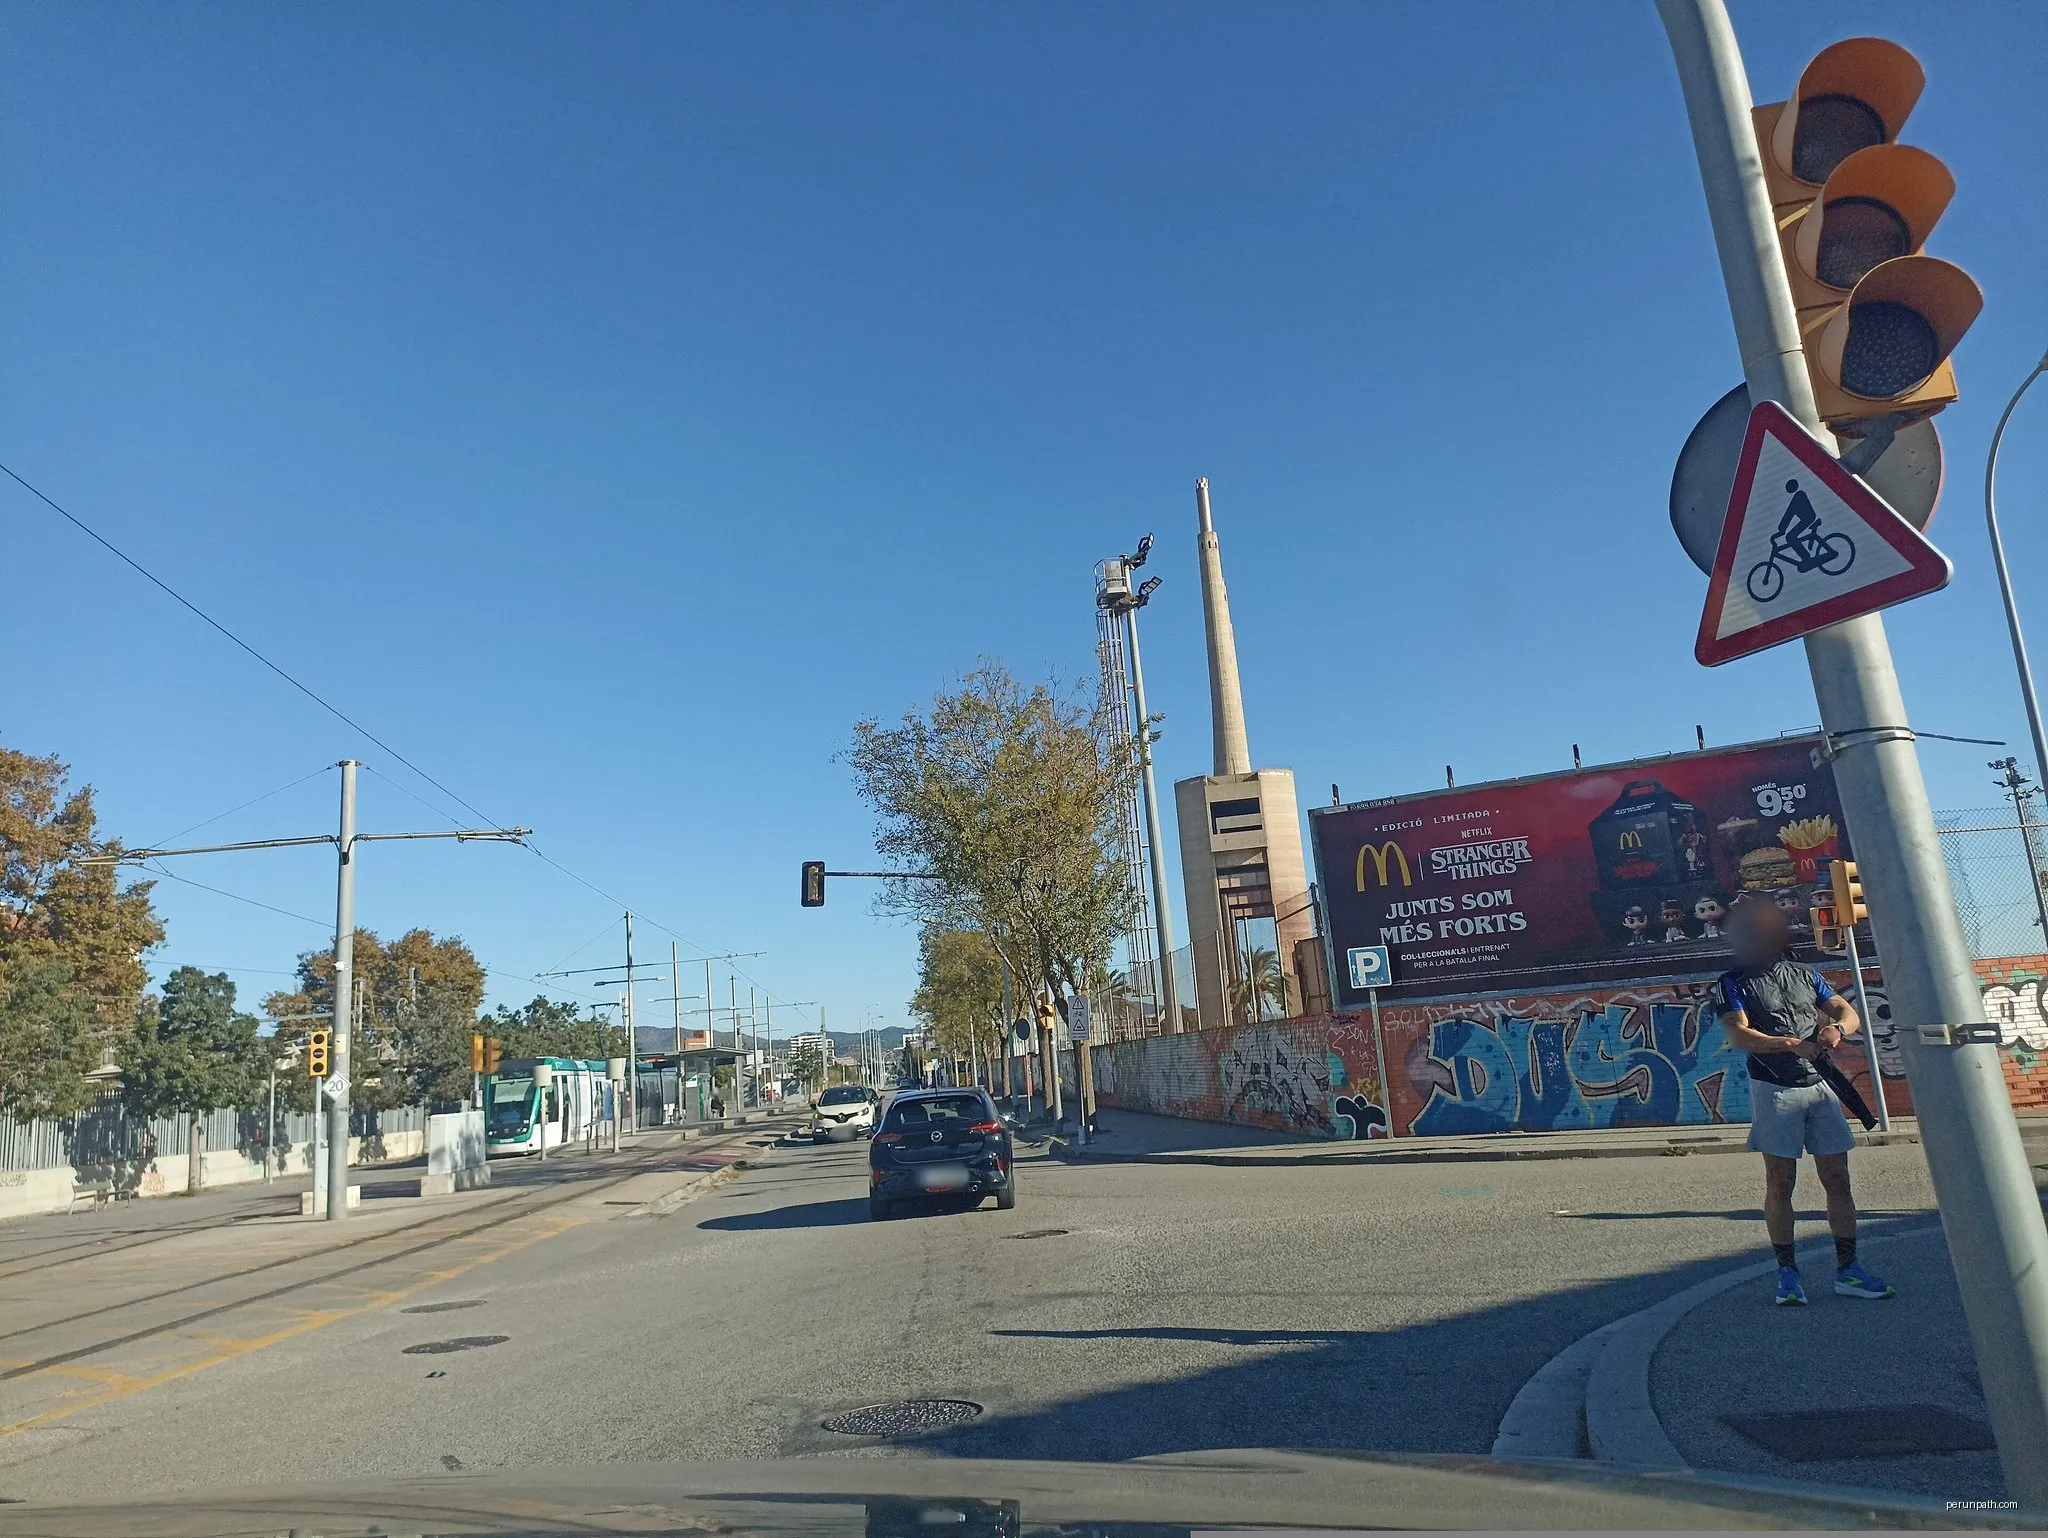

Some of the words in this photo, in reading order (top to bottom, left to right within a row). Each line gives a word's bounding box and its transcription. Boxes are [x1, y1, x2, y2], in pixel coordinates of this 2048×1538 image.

[1751, 782, 1777, 793] NOMÉS
[1382, 818, 1423, 832] EDICIÓ
[1434, 810, 1490, 824] LIMITADA
[1461, 827, 1493, 839] NETFLIX
[1431, 840, 1531, 870] STRANGER
[1448, 858, 1517, 881] THINGS
[1386, 896, 1455, 920] JUNTS
[1461, 889, 1514, 910] SOM
[1380, 919, 1433, 945] MÉS
[1439, 911, 1528, 939] FORTS
[1355, 951, 1381, 987] P
[1414, 961, 1428, 969] PER
[1446, 956, 1477, 966] BATALLA
[1478, 953, 1500, 962] FINAL
[328, 1080, 344, 1093] 20
